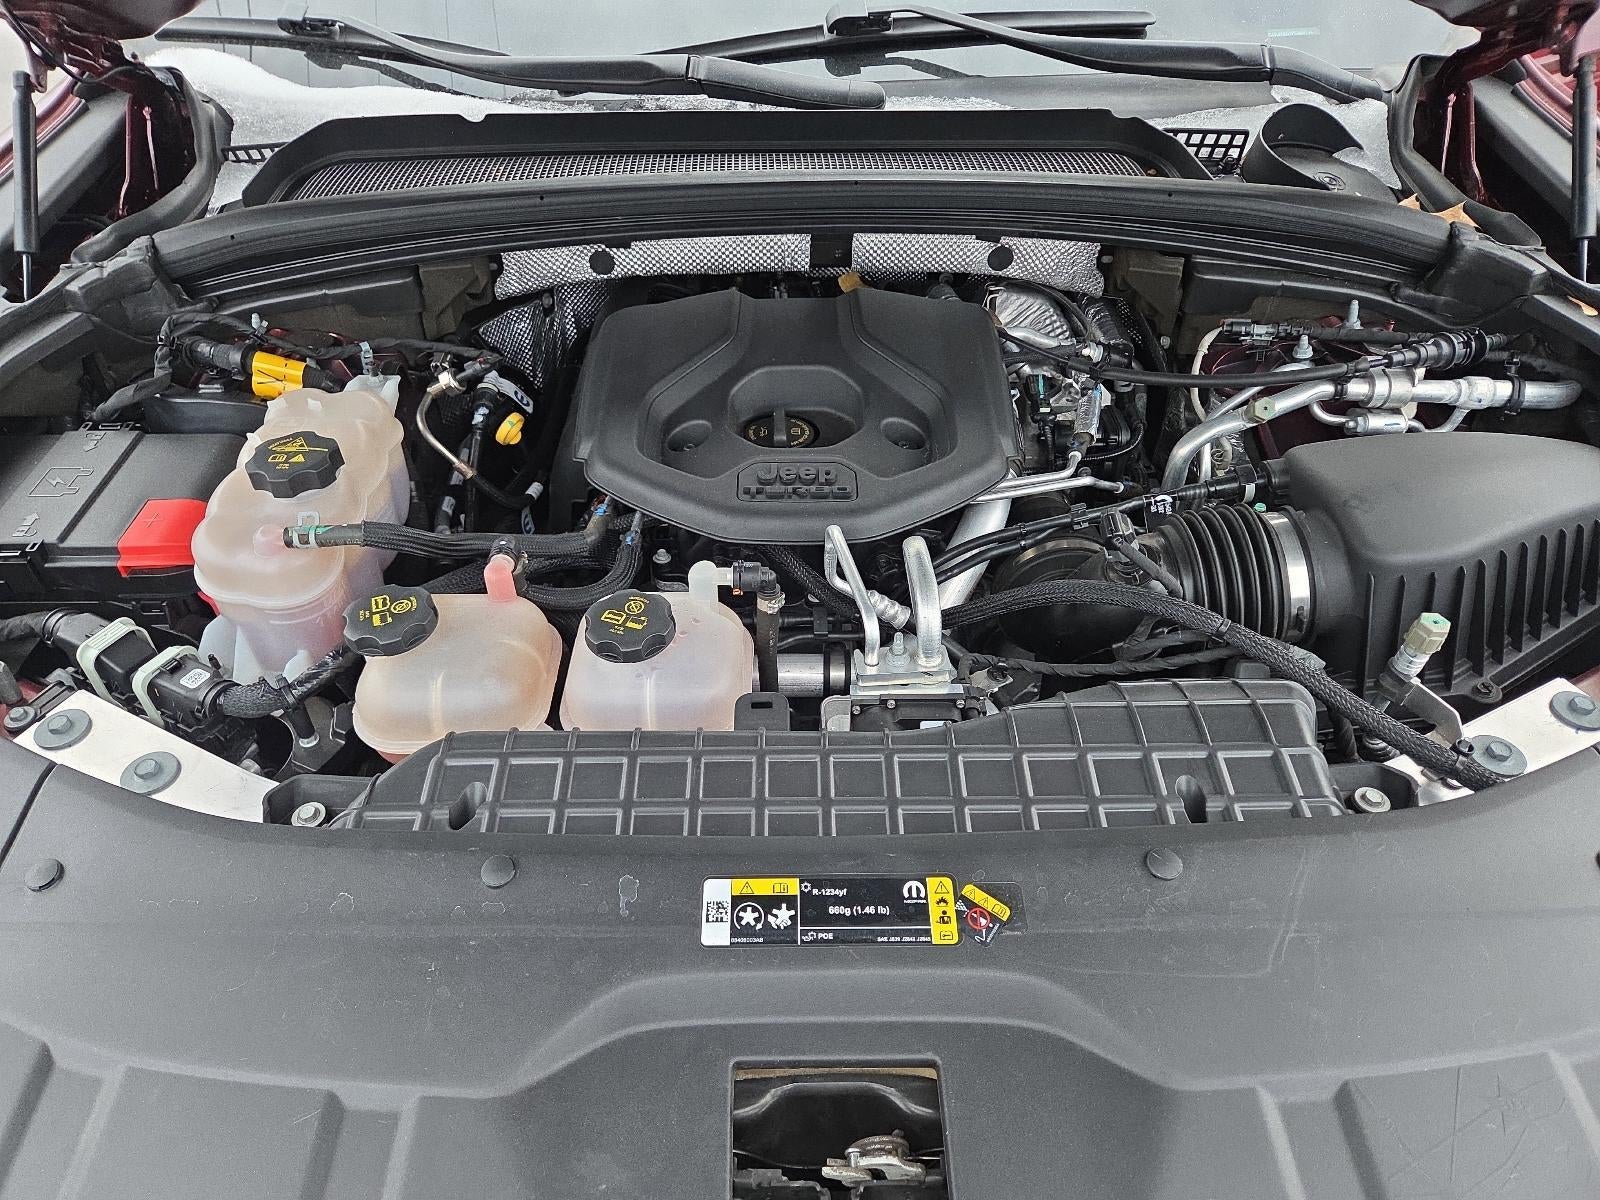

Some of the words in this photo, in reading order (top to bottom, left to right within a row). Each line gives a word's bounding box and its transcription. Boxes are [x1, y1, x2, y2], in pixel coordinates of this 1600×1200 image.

[757, 463, 838, 485] Jeep
[743, 486, 853, 499] TURBO
[812, 888, 848, 897] R-1234yf
[828, 906, 851, 916] 660g
[852, 905, 876, 916] (1.46
[877, 905, 890, 916] lb)
[817, 932, 834, 940] POE
